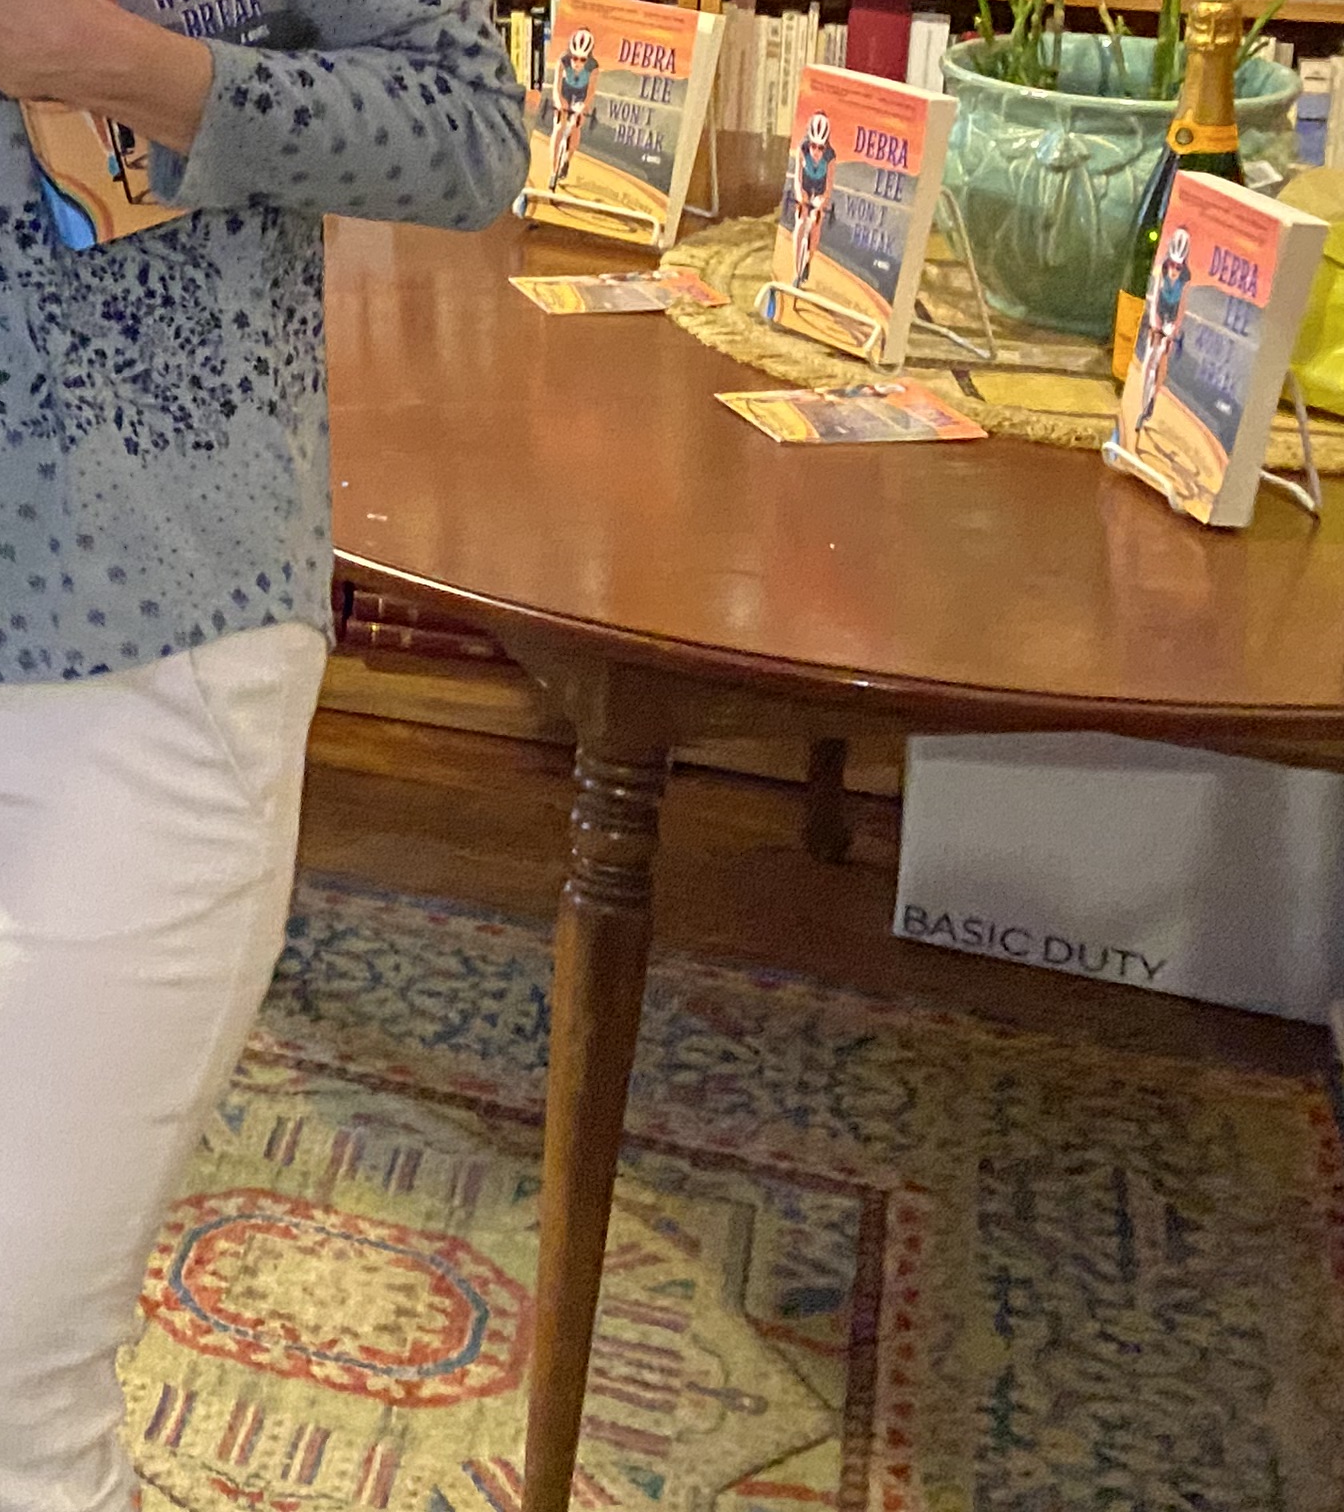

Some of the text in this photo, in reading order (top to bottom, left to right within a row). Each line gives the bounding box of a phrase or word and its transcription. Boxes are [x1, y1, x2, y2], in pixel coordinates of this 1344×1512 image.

[618, 37, 678, 75] DEBRA
[640, 76, 675, 104] LEE
[608, 99, 656, 127] WON'T
[853, 125, 909, 169] DEBRA
[874, 170, 906, 203] LEE
[1208, 244, 1260, 299] DEBRA
[903, 903, 1169, 982] BASIC DUTY
